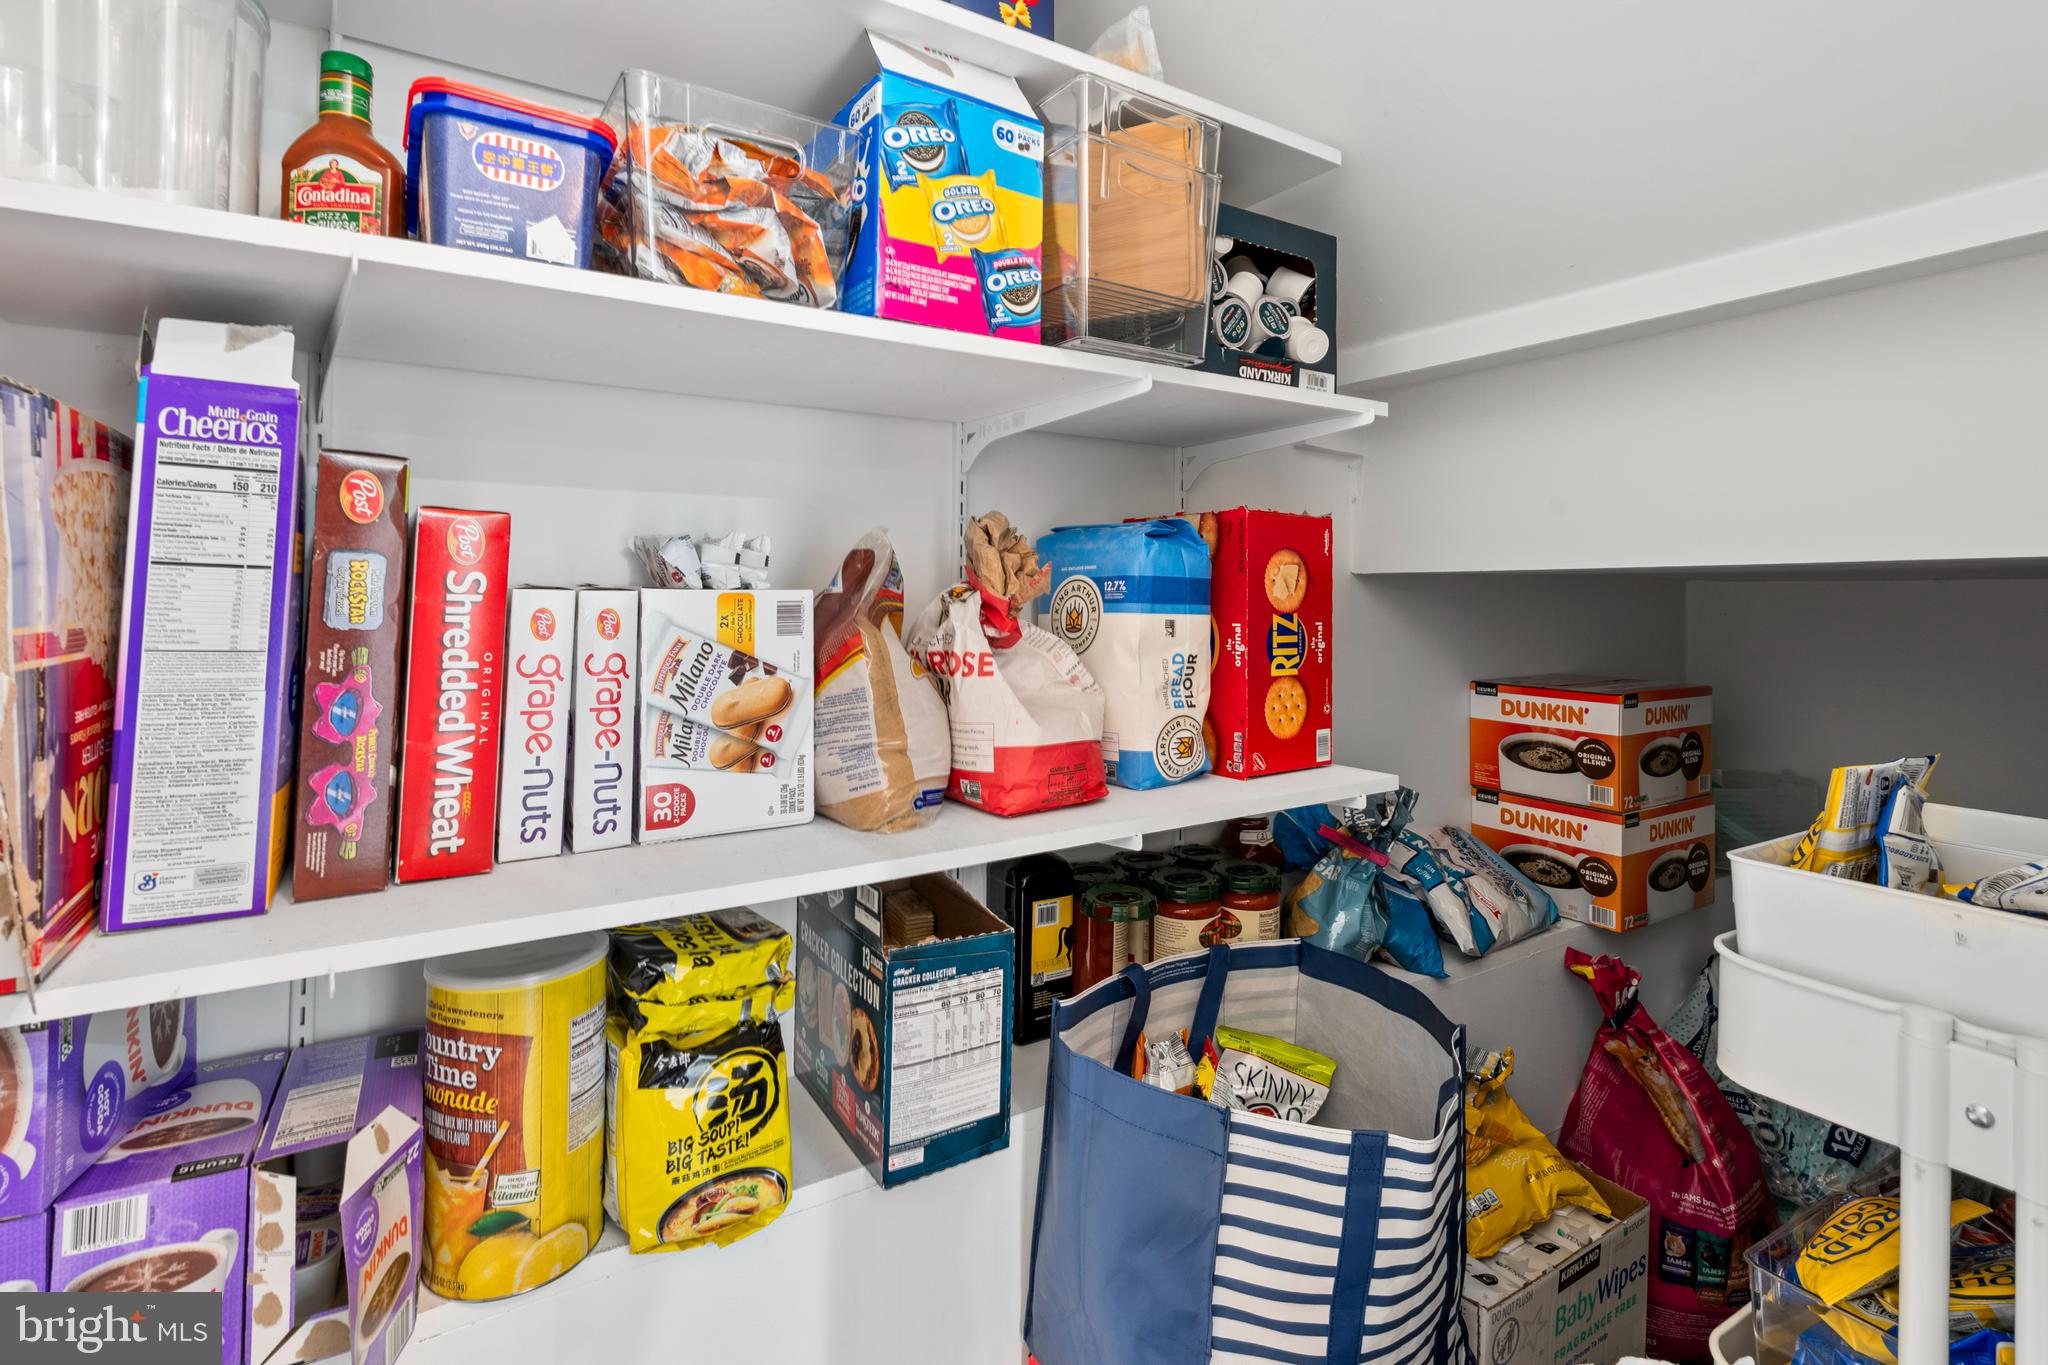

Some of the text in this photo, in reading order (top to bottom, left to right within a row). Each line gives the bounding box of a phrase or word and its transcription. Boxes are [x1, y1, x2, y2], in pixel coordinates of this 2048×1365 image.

[883, 126, 955, 147] OREO
[996, 126, 1041, 147] 60 PACKS
[896, 160, 908, 175] 2
[297, 186, 371, 206] Contadina
[943, 185, 980, 197] GOLDEN
[318, 211, 349, 220] PIZZA
[933, 199, 994, 221] OREO
[943, 232, 954, 245] 2
[993, 257, 1018, 268] DOUBLE
[987, 270, 1041, 292] OREO
[995, 304, 1004, 317] 2
[1239, 365, 1292, 386] KIRKLAND
[158, 406, 279, 445] Cheerios
[208, 405, 278, 423] Multi Grain
[159, 442, 190, 450] Nutrition
[218, 446, 236, 454] Datos
[232, 481, 249, 492] 150
[260, 484, 277, 494] 210
[349, 478, 377, 517] Post
[456, 524, 479, 560] Post
[348, 560, 369, 625] ROCKSTAR
[1104, 580, 1126, 591] 12.7%
[1054, 585, 1097, 615] KING ARTHUR
[536, 612, 551, 637] Post
[601, 612, 617, 637] Post
[720, 615, 729, 628] 2X
[1232, 623, 1245, 667] original
[1271, 613, 1299, 677] RITZ
[1315, 622, 1326, 663] original
[653, 639, 687, 694] PEPPERIDGE FARM
[670, 640, 714, 715] Milano
[691, 652, 723, 711] DOUBLE DARK
[700, 660, 727, 709] CHOCOLATE
[1160, 658, 1169, 710] UNBLEACHED
[1172, 652, 1185, 709] BREAD
[1183, 653, 1198, 709] FLOUR
[1477, 687, 1497, 695] KEURIG
[479, 652, 493, 745] ORIGINAL
[430, 570, 487, 857] Shredded Wheat
[1501, 699, 1589, 724] DUNKIN'
[1645, 704, 1691, 726] DUNKIN'
[584, 652, 630, 836] grape-nuts
[767, 728, 777, 739] 2
[1159, 721, 1181, 758] ARTHUR
[515, 653, 565, 843] grape-nuts
[1577, 751, 1612, 762] ORIGINAL
[1682, 750, 1701, 758] ORIGINAL
[761, 756, 770, 764] 2
[1161, 758, 1180, 776] KING
[1583, 758, 1606, 767] BLEND
[1685, 755, 1699, 765] BLEND
[653, 792, 672, 823] 30
[1478, 792, 1498, 801] KEURIG
[1624, 796, 1633, 809] 72
[1500, 807, 1589, 841] DUNKIN'
[1649, 815, 1696, 841] DUNKIN'
[1580, 869, 1614, 882] ORIGINAL
[1688, 861, 1708, 870] ORIGINAL
[1691, 867, 1706, 876] BLEND
[1585, 875, 1608, 886] BLEND
[1624, 915, 1634, 930] 72
[801, 922, 880, 1011] CRACKER COLLECTION
[862, 944, 871, 969] 13
[893, 967, 957, 987] CRACKER COLLECTION
[447, 1007, 504, 1020] sweeteners
[894, 988, 1001, 1017] Calories 80 70 80 70
[438, 1013, 466, 1026] flavors
[425, 1032, 503, 1071] ountry
[425, 1060, 477, 1090] Time
[127, 1100, 253, 1134] DUNKIN'
[445, 1114, 497, 1134] MIX WITH OTHER
[448, 1129, 469, 1146] FLAVOR
[667, 1117, 741, 1156] BIG SOUP!
[1831, 1127, 1856, 1154] 12
[406, 1140, 419, 1163] 22
[666, 1155, 692, 1174] BIG
[700, 1132, 750, 1165] TASTE!
[1850, 1137, 1866, 1160] ROLLS
[178, 1157, 239, 1176] KEURIG
[492, 1185, 542, 1201] Vitamin C
[1682, 1194, 1701, 1204] IAMS
[1810, 1203, 1879, 1249] GOLD
[1824, 1207, 1900, 1255] ROLD
[360, 1216, 408, 1297] DUNKIN'
[1561, 1249, 1600, 1283] KIRKLAND
[1492, 1290, 1533, 1325] DO NOT FLUSH
[1554, 1294, 1637, 1361] FRAGRANCE FREE
